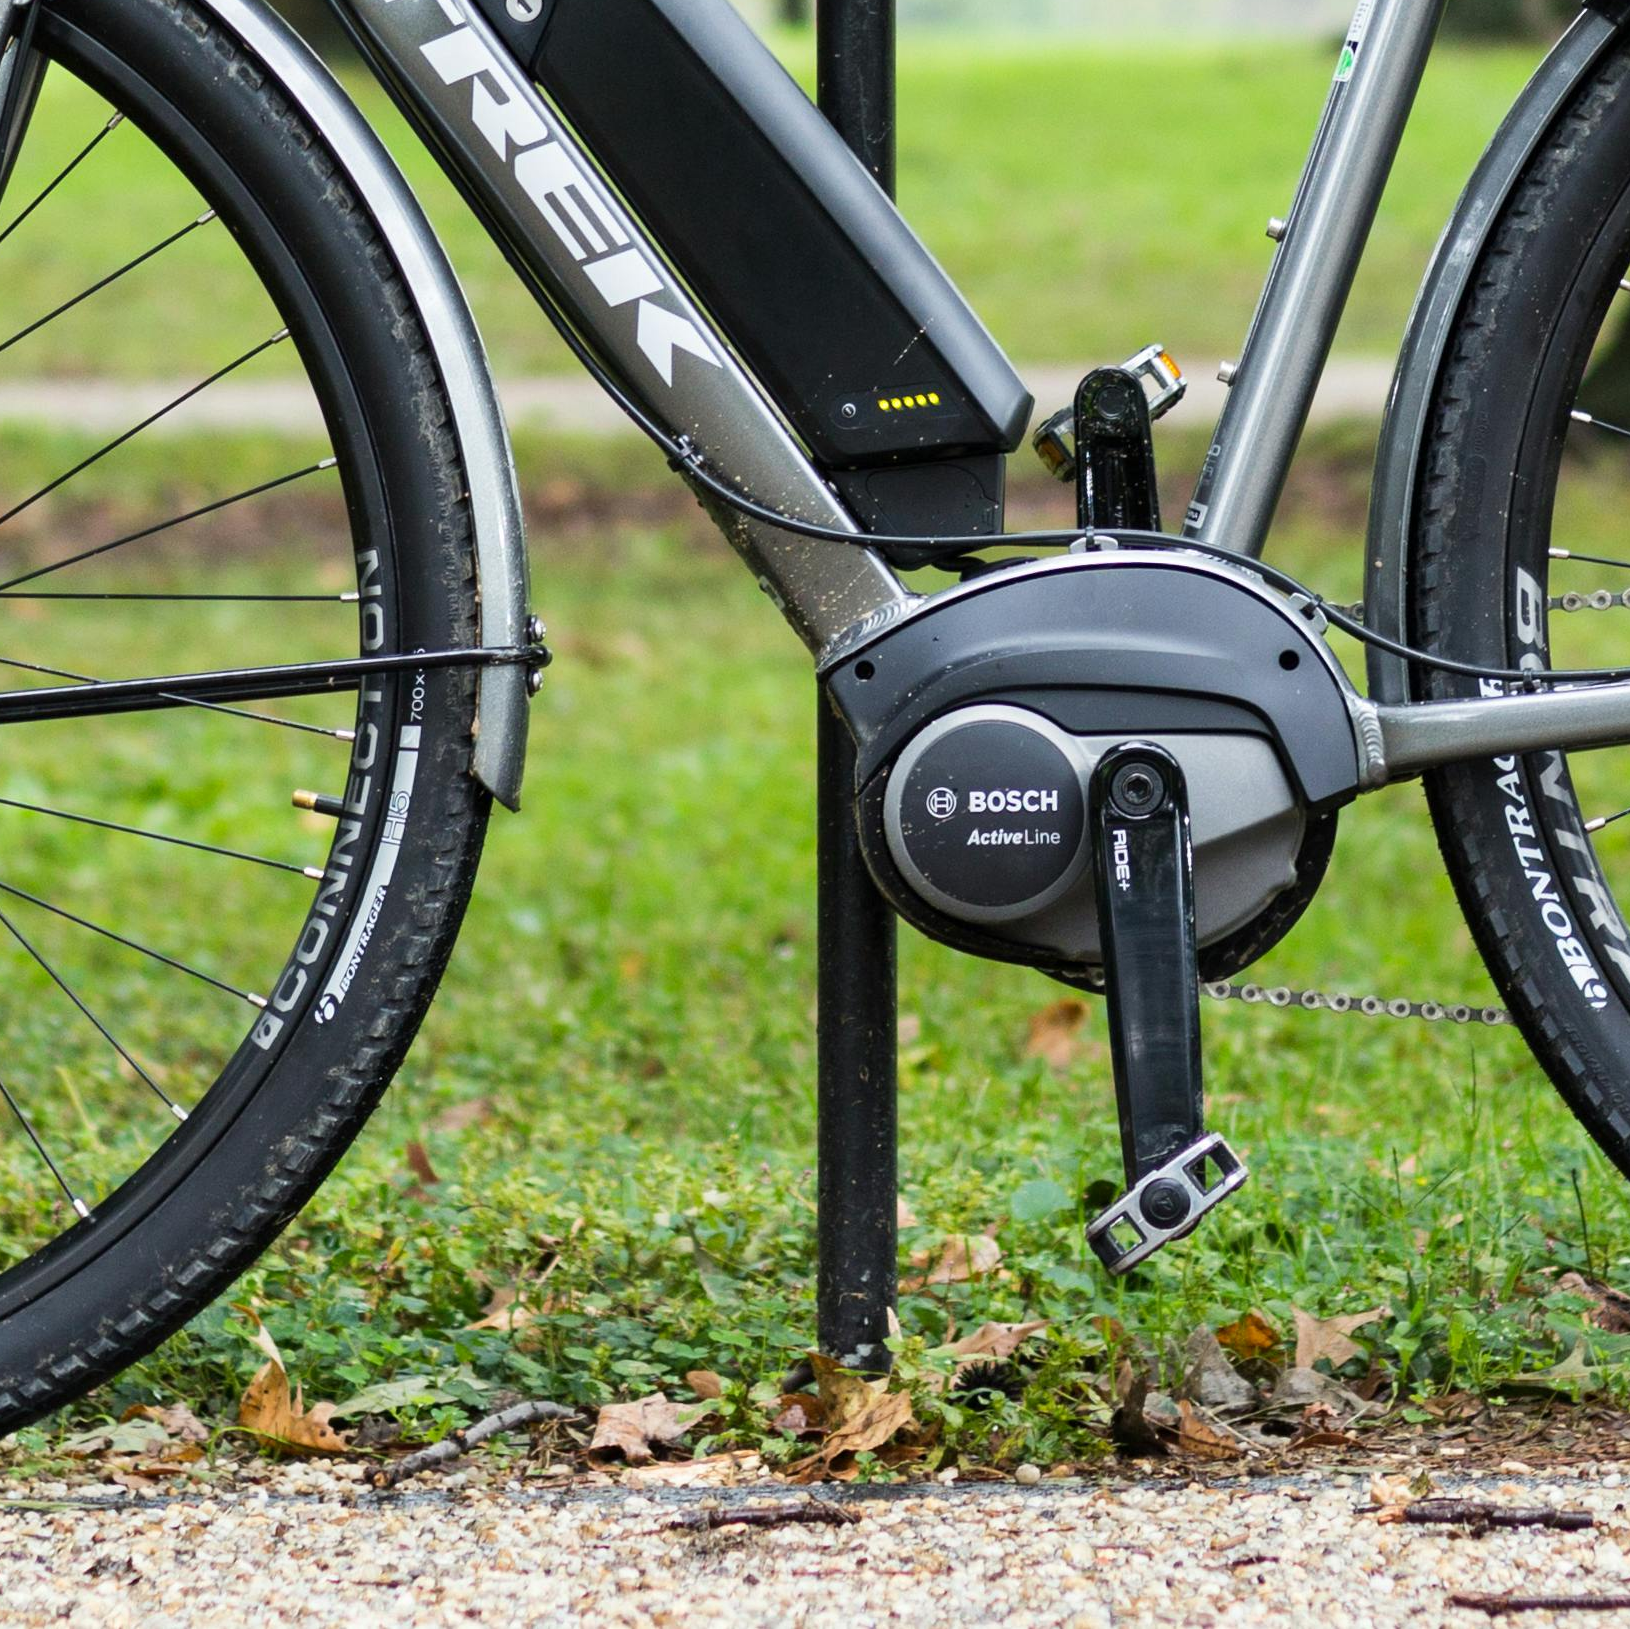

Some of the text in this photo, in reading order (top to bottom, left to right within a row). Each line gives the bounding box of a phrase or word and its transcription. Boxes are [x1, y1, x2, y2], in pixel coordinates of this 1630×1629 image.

[273, 548, 384, 1012] CONNECTON
[339, 885, 388, 992] BONTRAGER
[410, 648, 426, 722] 700x
[969, 790, 1058, 813] BOSCH
[1112, 829, 1131, 892] RIDE+
[1478, 678, 1573, 970] BONTRAR
